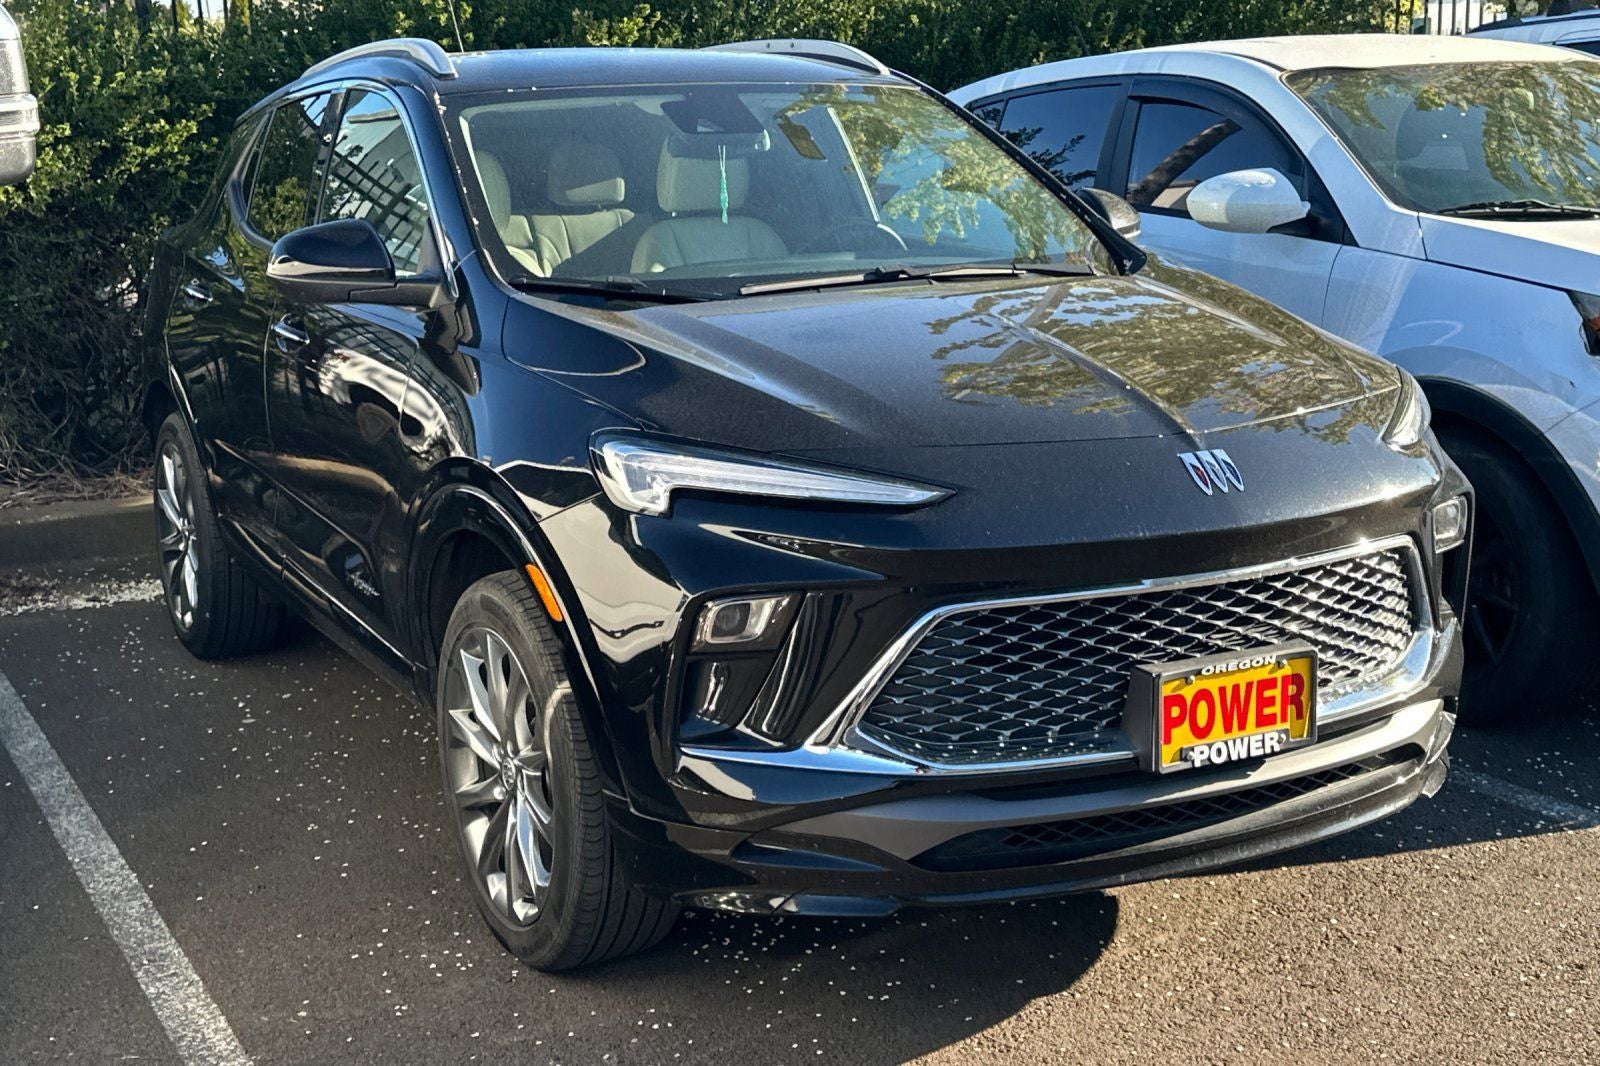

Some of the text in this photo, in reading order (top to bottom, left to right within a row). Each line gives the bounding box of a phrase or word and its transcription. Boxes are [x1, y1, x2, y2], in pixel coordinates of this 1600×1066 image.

[1201, 655, 1277, 676] OREGON
[1162, 672, 1305, 745] POWER
[1194, 731, 1281, 768] POWER
